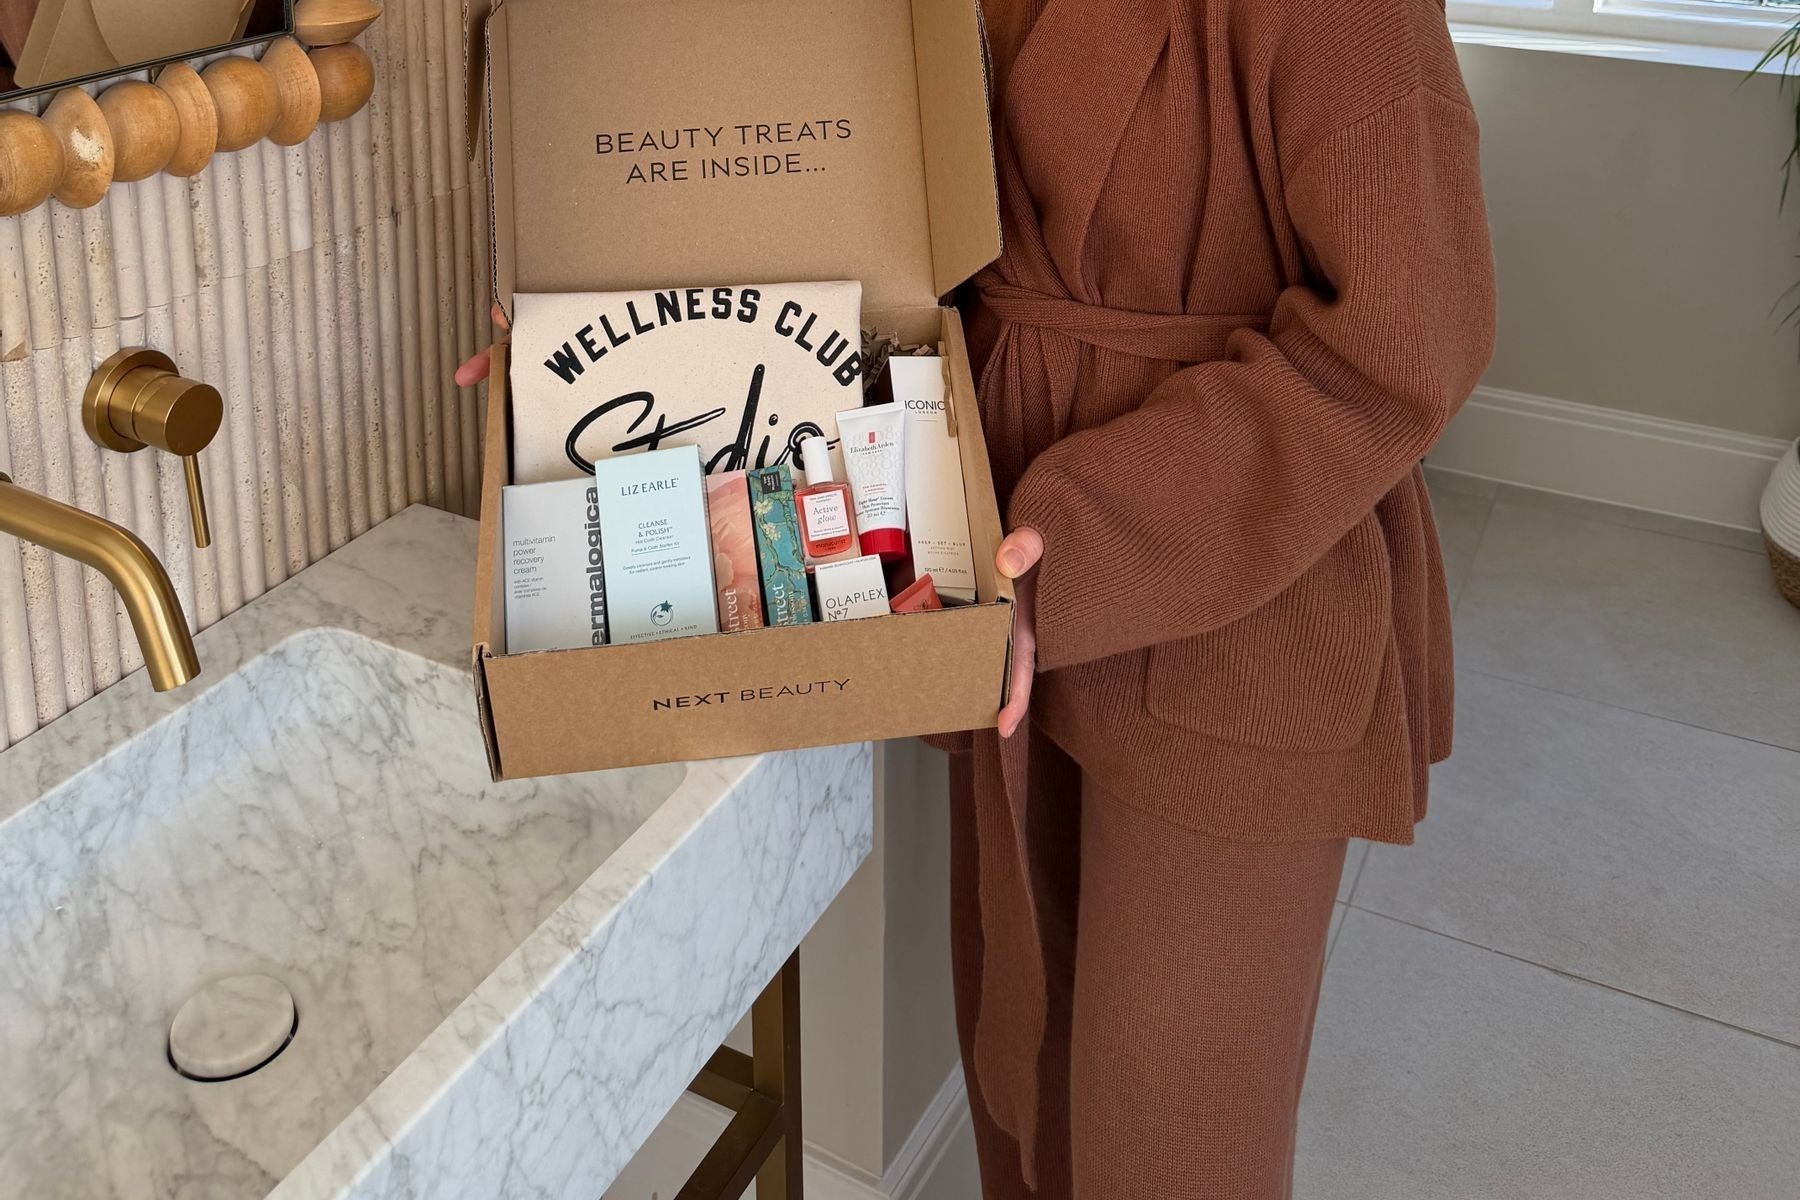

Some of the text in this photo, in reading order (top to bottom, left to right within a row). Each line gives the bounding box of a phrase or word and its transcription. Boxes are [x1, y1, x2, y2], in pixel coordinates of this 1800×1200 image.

[596, 119, 852, 155] BEAUTY TREATS
[626, 153, 826, 184] ARE INSIDE...
[543, 287, 862, 387] WELLNESS CLUB
[904, 400, 946, 410] ICONIC
[565, 363, 841, 476] Stdio
[621, 484, 639, 496] LIZ
[813, 505, 838, 515] Active
[638, 519, 668, 529] CLEANSE
[818, 515, 836, 525] glow
[513, 536, 556, 546] multivitamin
[513, 548, 536, 557] power
[513, 556, 544, 565] recovery
[584, 486, 606, 646] ermalogica
[826, 588, 885, 609] OLAPLEX
[653, 678, 850, 710] NEXT BEAUTY
